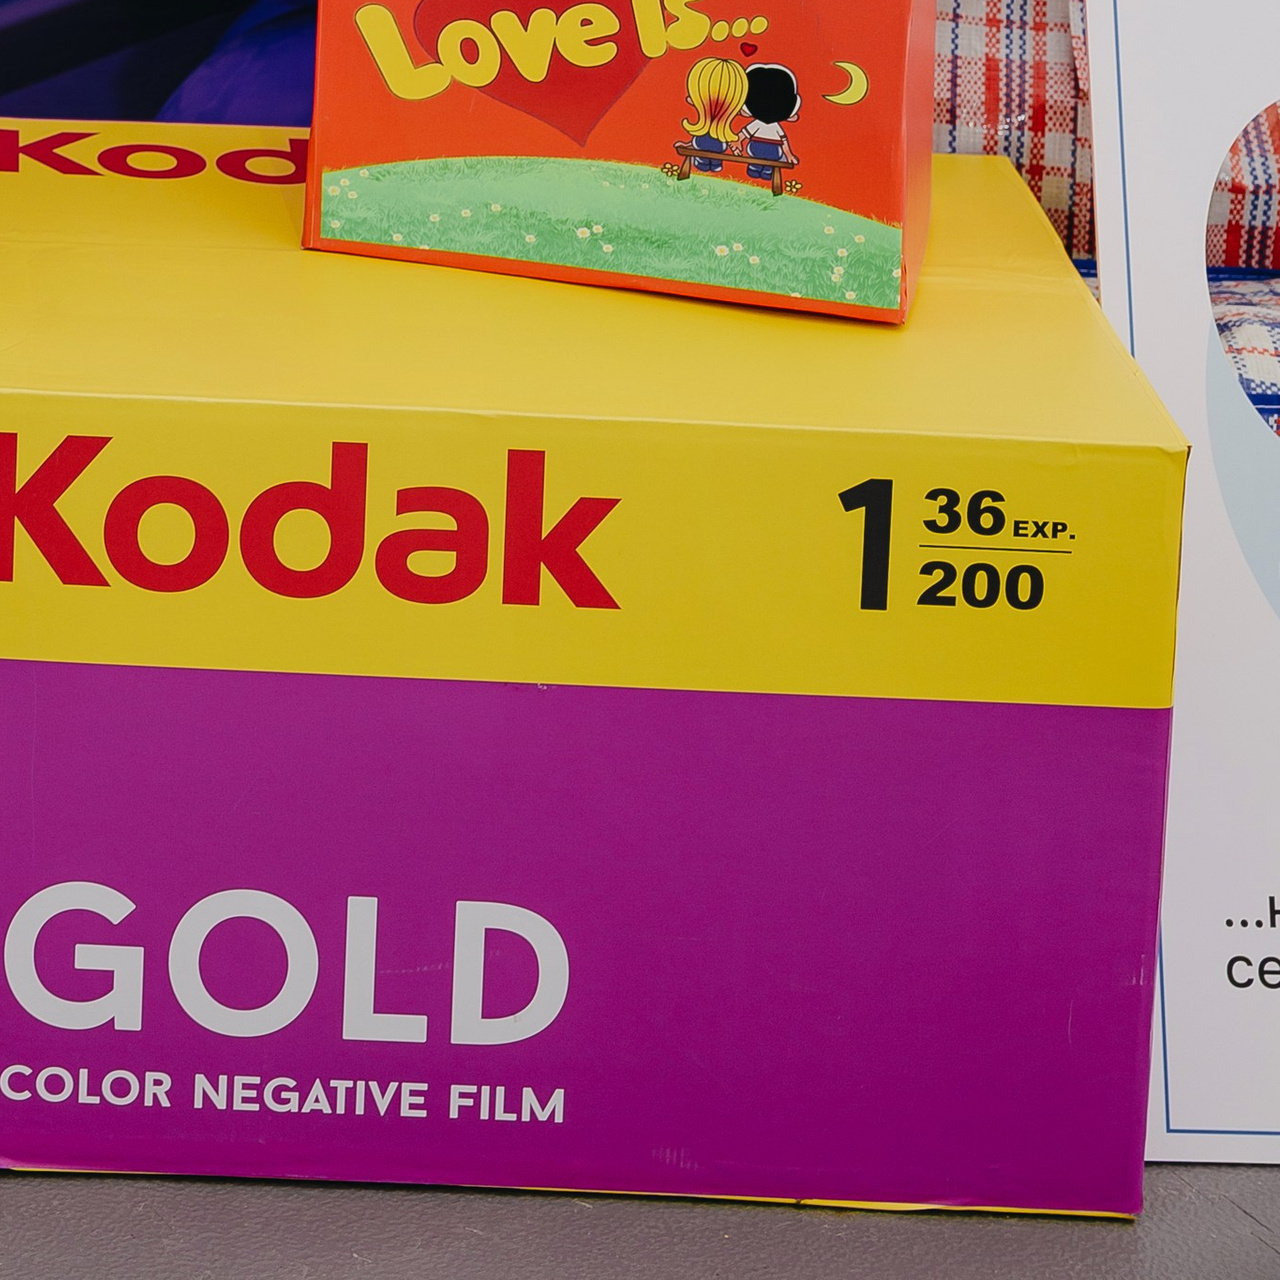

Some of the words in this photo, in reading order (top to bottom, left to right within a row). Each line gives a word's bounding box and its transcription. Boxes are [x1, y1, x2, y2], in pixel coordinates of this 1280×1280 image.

[355, 2, 621, 101] Love
[837, 478, 894, 611] 1
[922, 487, 1006, 536] 36
[1012, 519, 1076, 540] EXP.
[916, 560, 1045, 611] 200
[3, 880, 571, 1046] GOLD
[0, 1064, 172, 1108] COLOR
[193, 1073, 429, 1118] NEGATIVE
[448, 1084, 566, 1124] FILM
